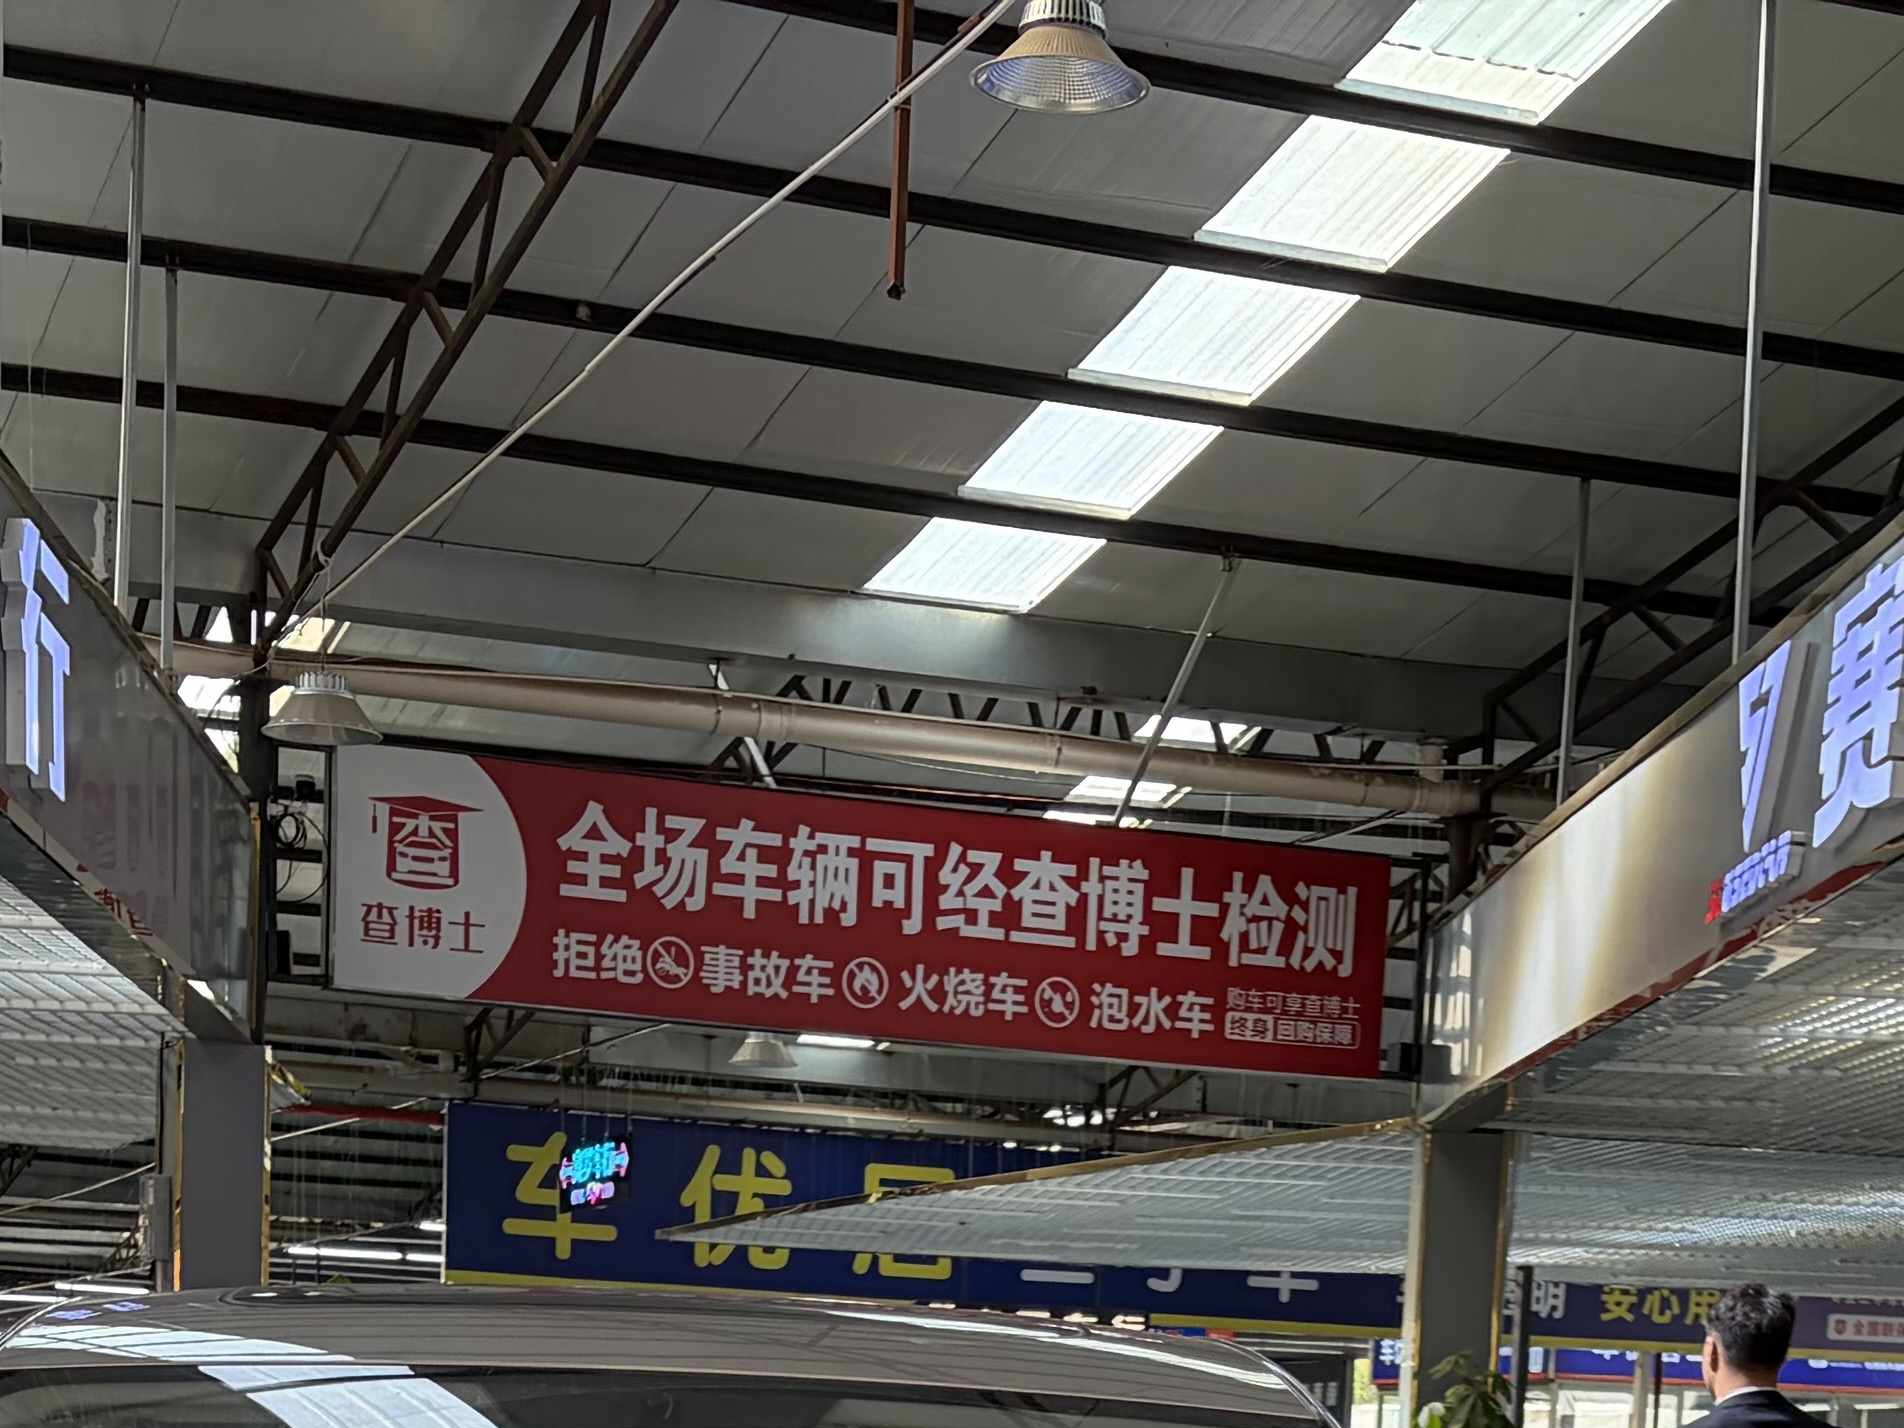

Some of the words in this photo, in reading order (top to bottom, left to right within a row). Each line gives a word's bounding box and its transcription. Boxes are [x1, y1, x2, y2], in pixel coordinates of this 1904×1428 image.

[359, 901, 487, 954] 查博士
[555, 799, 1358, 978] 全场车辆可经查博士检测
[552, 927, 645, 985] 拒绝
[699, 944, 836, 1004] 事故车
[898, 962, 1030, 1021] 火烧车
[1089, 981, 1216, 1040] 泡水车
